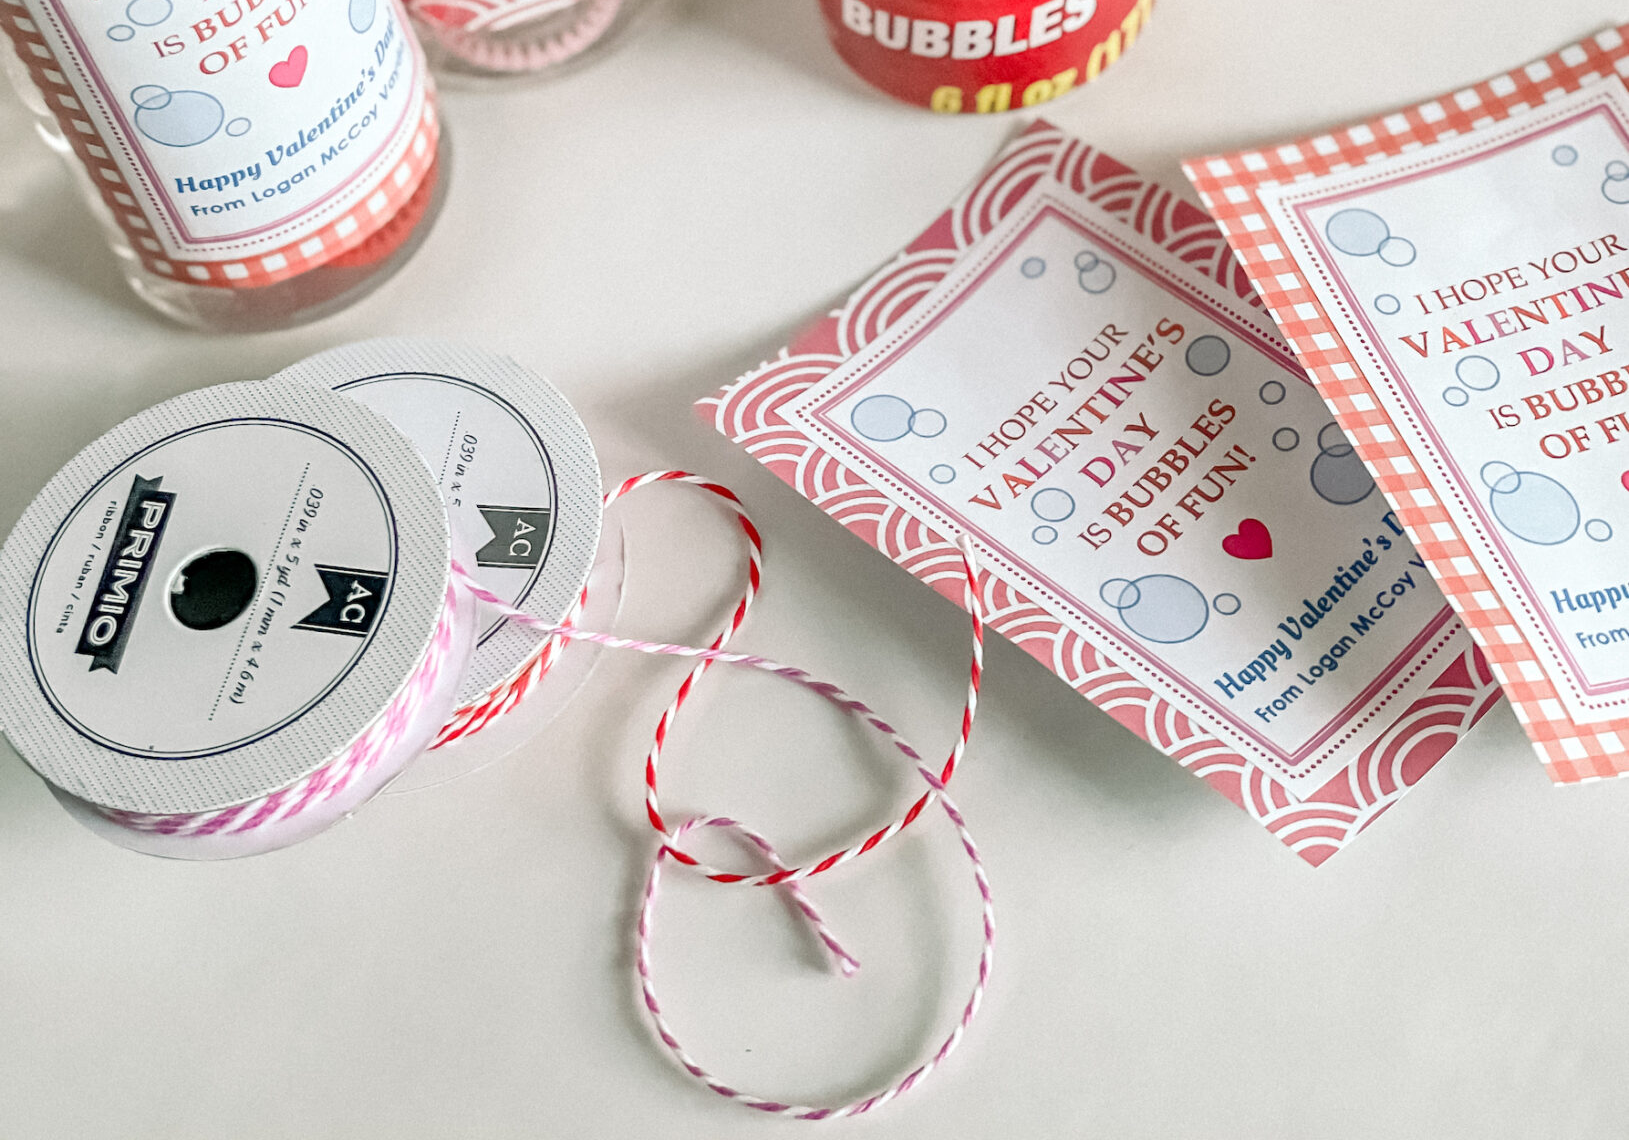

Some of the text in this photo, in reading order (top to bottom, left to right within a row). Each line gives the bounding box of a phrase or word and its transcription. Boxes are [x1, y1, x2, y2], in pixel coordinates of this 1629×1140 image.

[151, 33, 186, 58] IS
[198, 35, 249, 75] OF
[174, 162, 262, 194] Happy
[264, 68, 376, 166] Valentine's
[190, 198, 246, 217] From
[250, 164, 317, 203] Logan
[320, 103, 378, 166] McCoy
[1413, 233, 1628, 315] I HOPE YOUR
[1516, 325, 1613, 377] DAY
[962, 323, 1130, 470] I HOPE YOUR
[968, 317, 1186, 511] VALENTINE'S
[1486, 404, 1521, 430] IS
[1078, 412, 1160, 488] DAY
[1539, 425, 1591, 460] OF
[451, 482, 462, 491] x
[455, 463, 469, 476] in
[1077, 398, 1236, 551] IS BUBBLES
[1136, 444, 1257, 557] OF FUN!
[290, 537, 302, 548] x
[296, 518, 312, 533] in
[508, 517, 537, 557] AC
[55, 500, 118, 634] ribbon / ruban / cinta
[276, 565, 291, 588] yd
[286, 553, 300, 565] 5
[270, 591, 286, 606] (1
[339, 580, 373, 624] AC
[1213, 637, 1294, 700] Happy
[1277, 535, 1393, 641] Valentine's
[257, 607, 275, 636] mm
[1575, 627, 1629, 649] From
[251, 641, 263, 652] x
[1254, 684, 1304, 724] From
[1296, 635, 1357, 687] Logan
[1349, 570, 1417, 637] McCoy
